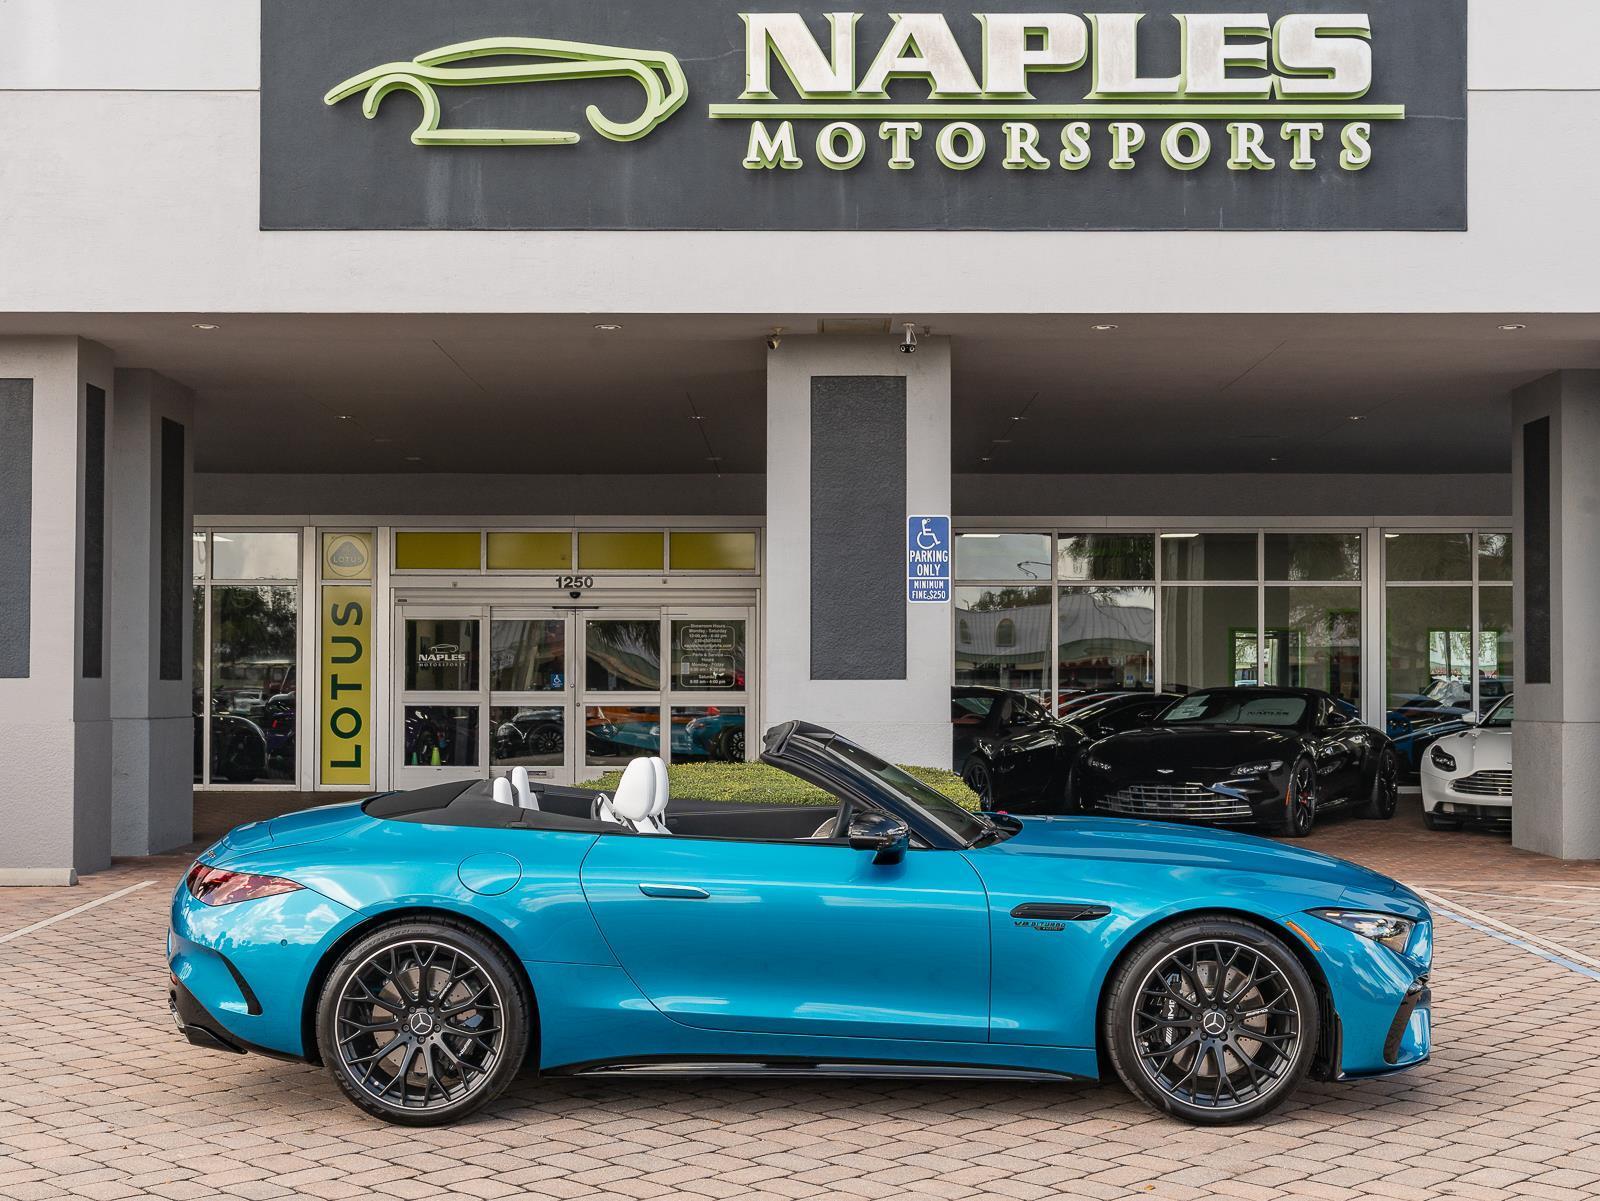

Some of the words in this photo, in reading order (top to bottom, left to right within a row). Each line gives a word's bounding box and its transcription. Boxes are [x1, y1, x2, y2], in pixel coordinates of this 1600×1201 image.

[737, 12, 1372, 100] NAPLES
[742, 120, 1373, 171] MOTORSPORTS
[332, 555, 363, 563] LOTUS
[909, 550, 948, 562] PARKING
[916, 563, 941, 576] ONLY
[555, 576, 594, 589] 1250
[913, 580, 944, 589] MINIMUM
[911, 590, 927, 599] FINE
[929, 590, 946, 600] $250
[330, 601, 363, 768] LOTUS
